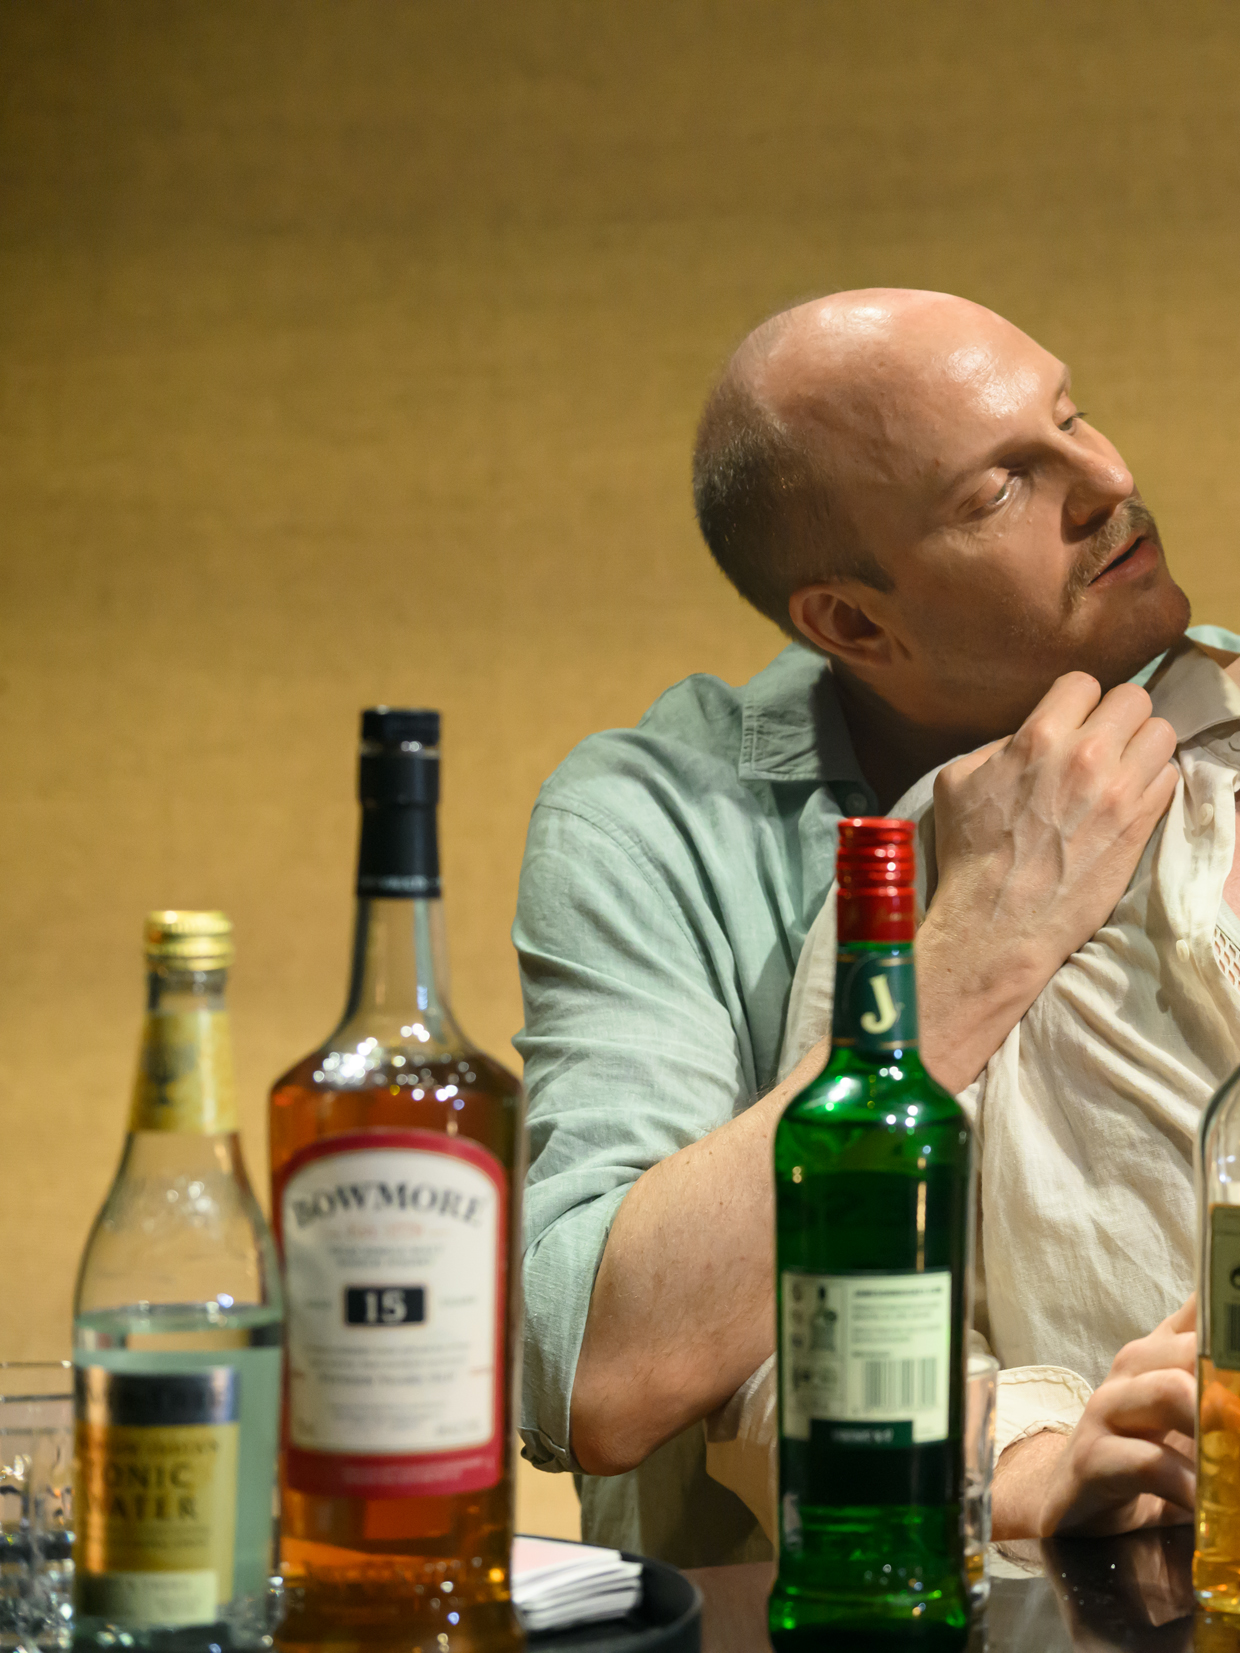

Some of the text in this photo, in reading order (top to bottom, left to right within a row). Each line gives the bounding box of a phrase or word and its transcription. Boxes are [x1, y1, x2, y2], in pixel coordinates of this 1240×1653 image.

[860, 974, 897, 1034] J
[292, 1179, 486, 1230] BOWMORE
[364, 1288, 408, 1323] 15
[94, 1461, 192, 1490] ONIC
[94, 1493, 198, 1521] ATER
